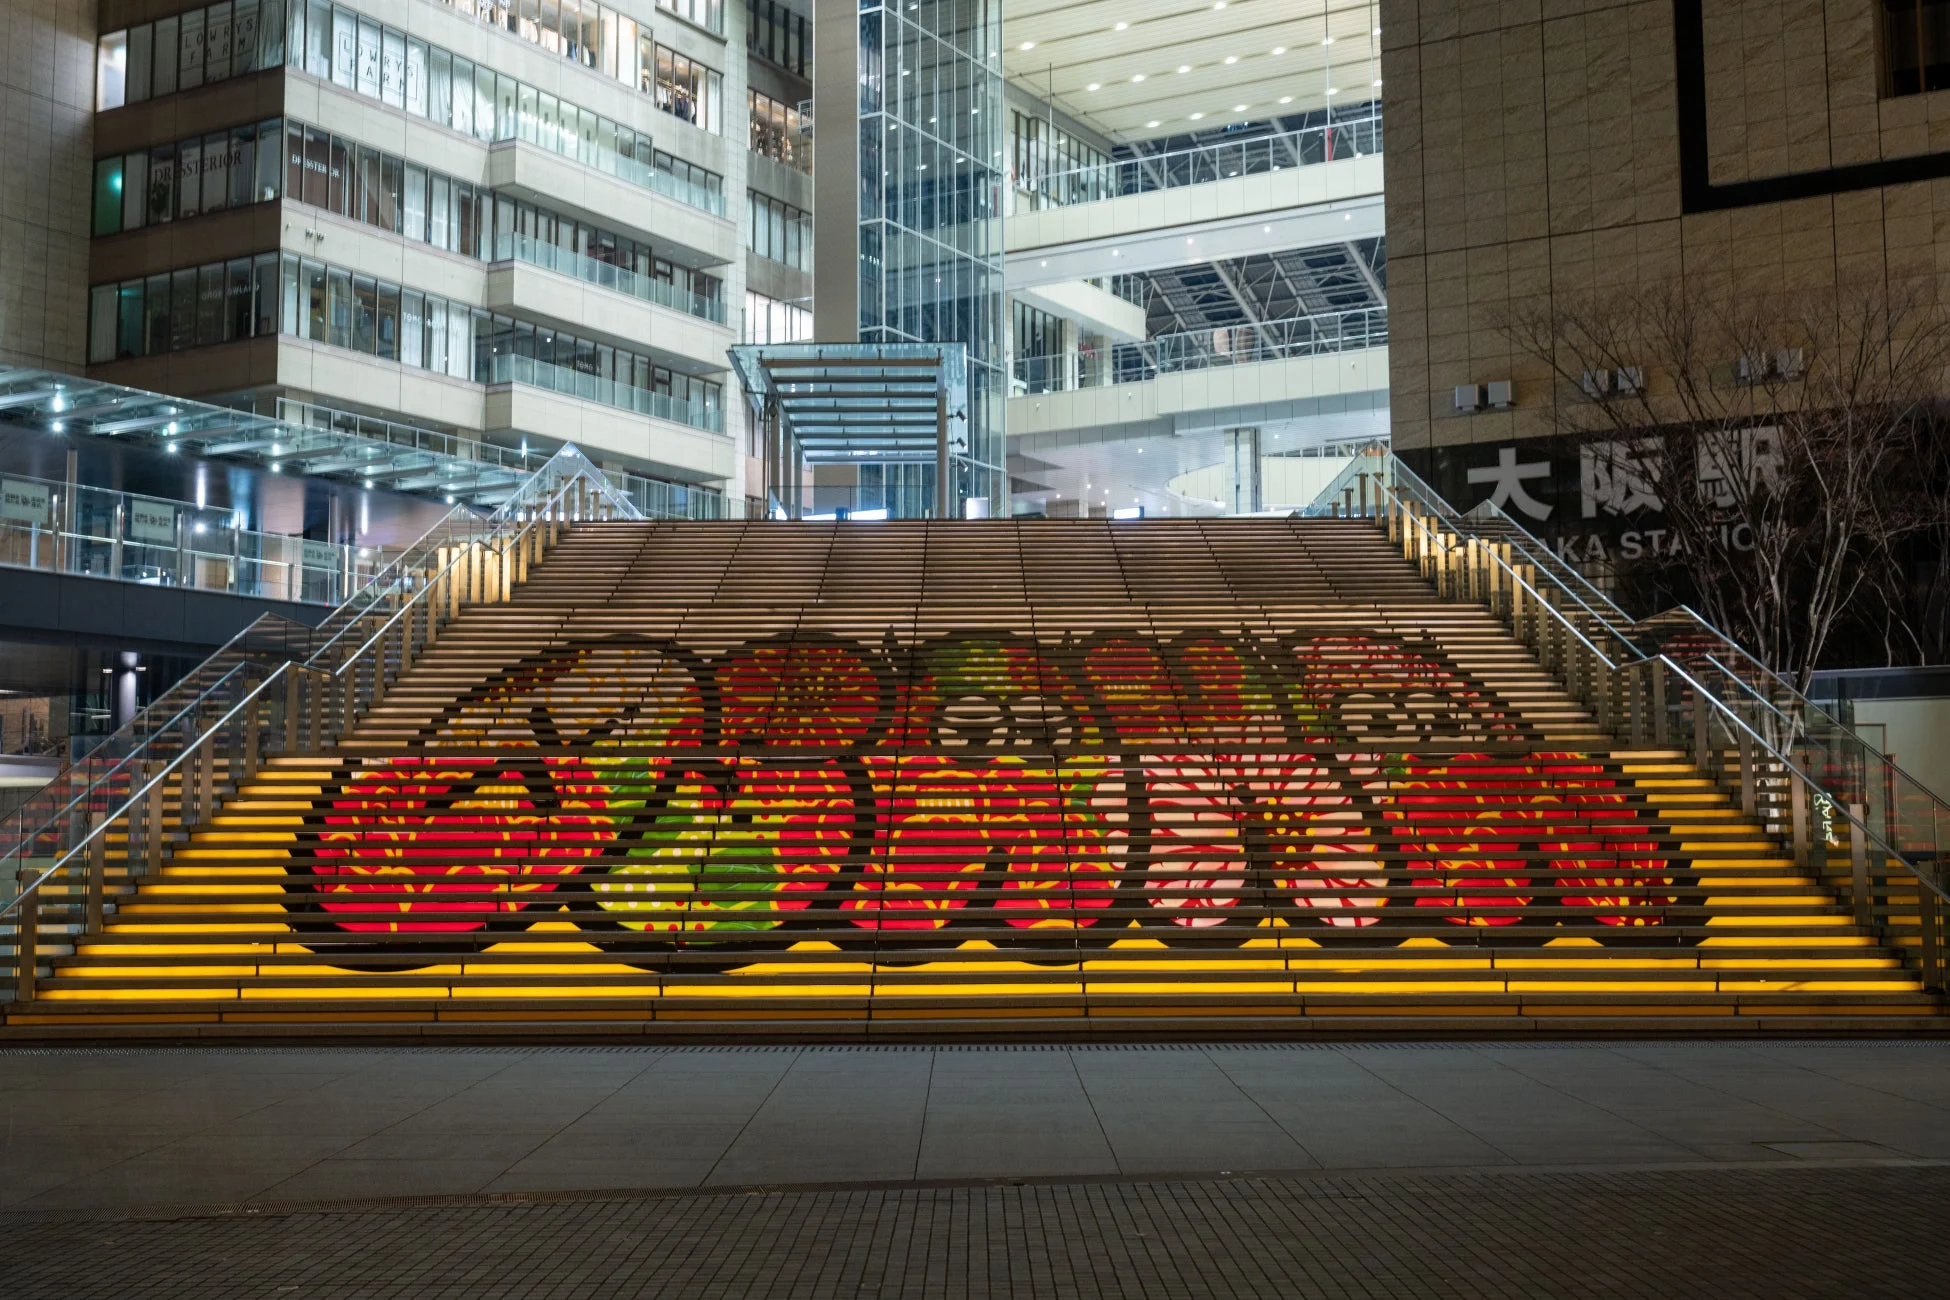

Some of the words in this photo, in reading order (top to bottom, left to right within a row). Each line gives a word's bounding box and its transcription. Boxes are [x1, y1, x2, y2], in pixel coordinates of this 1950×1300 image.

[185, 18, 253, 48] LOWRYS
[154, 151, 242, 183] DRSSTERIOR
[291, 153, 340, 178] DRSSTEROR
[1467, 425, 1786, 521] 大阪駅
